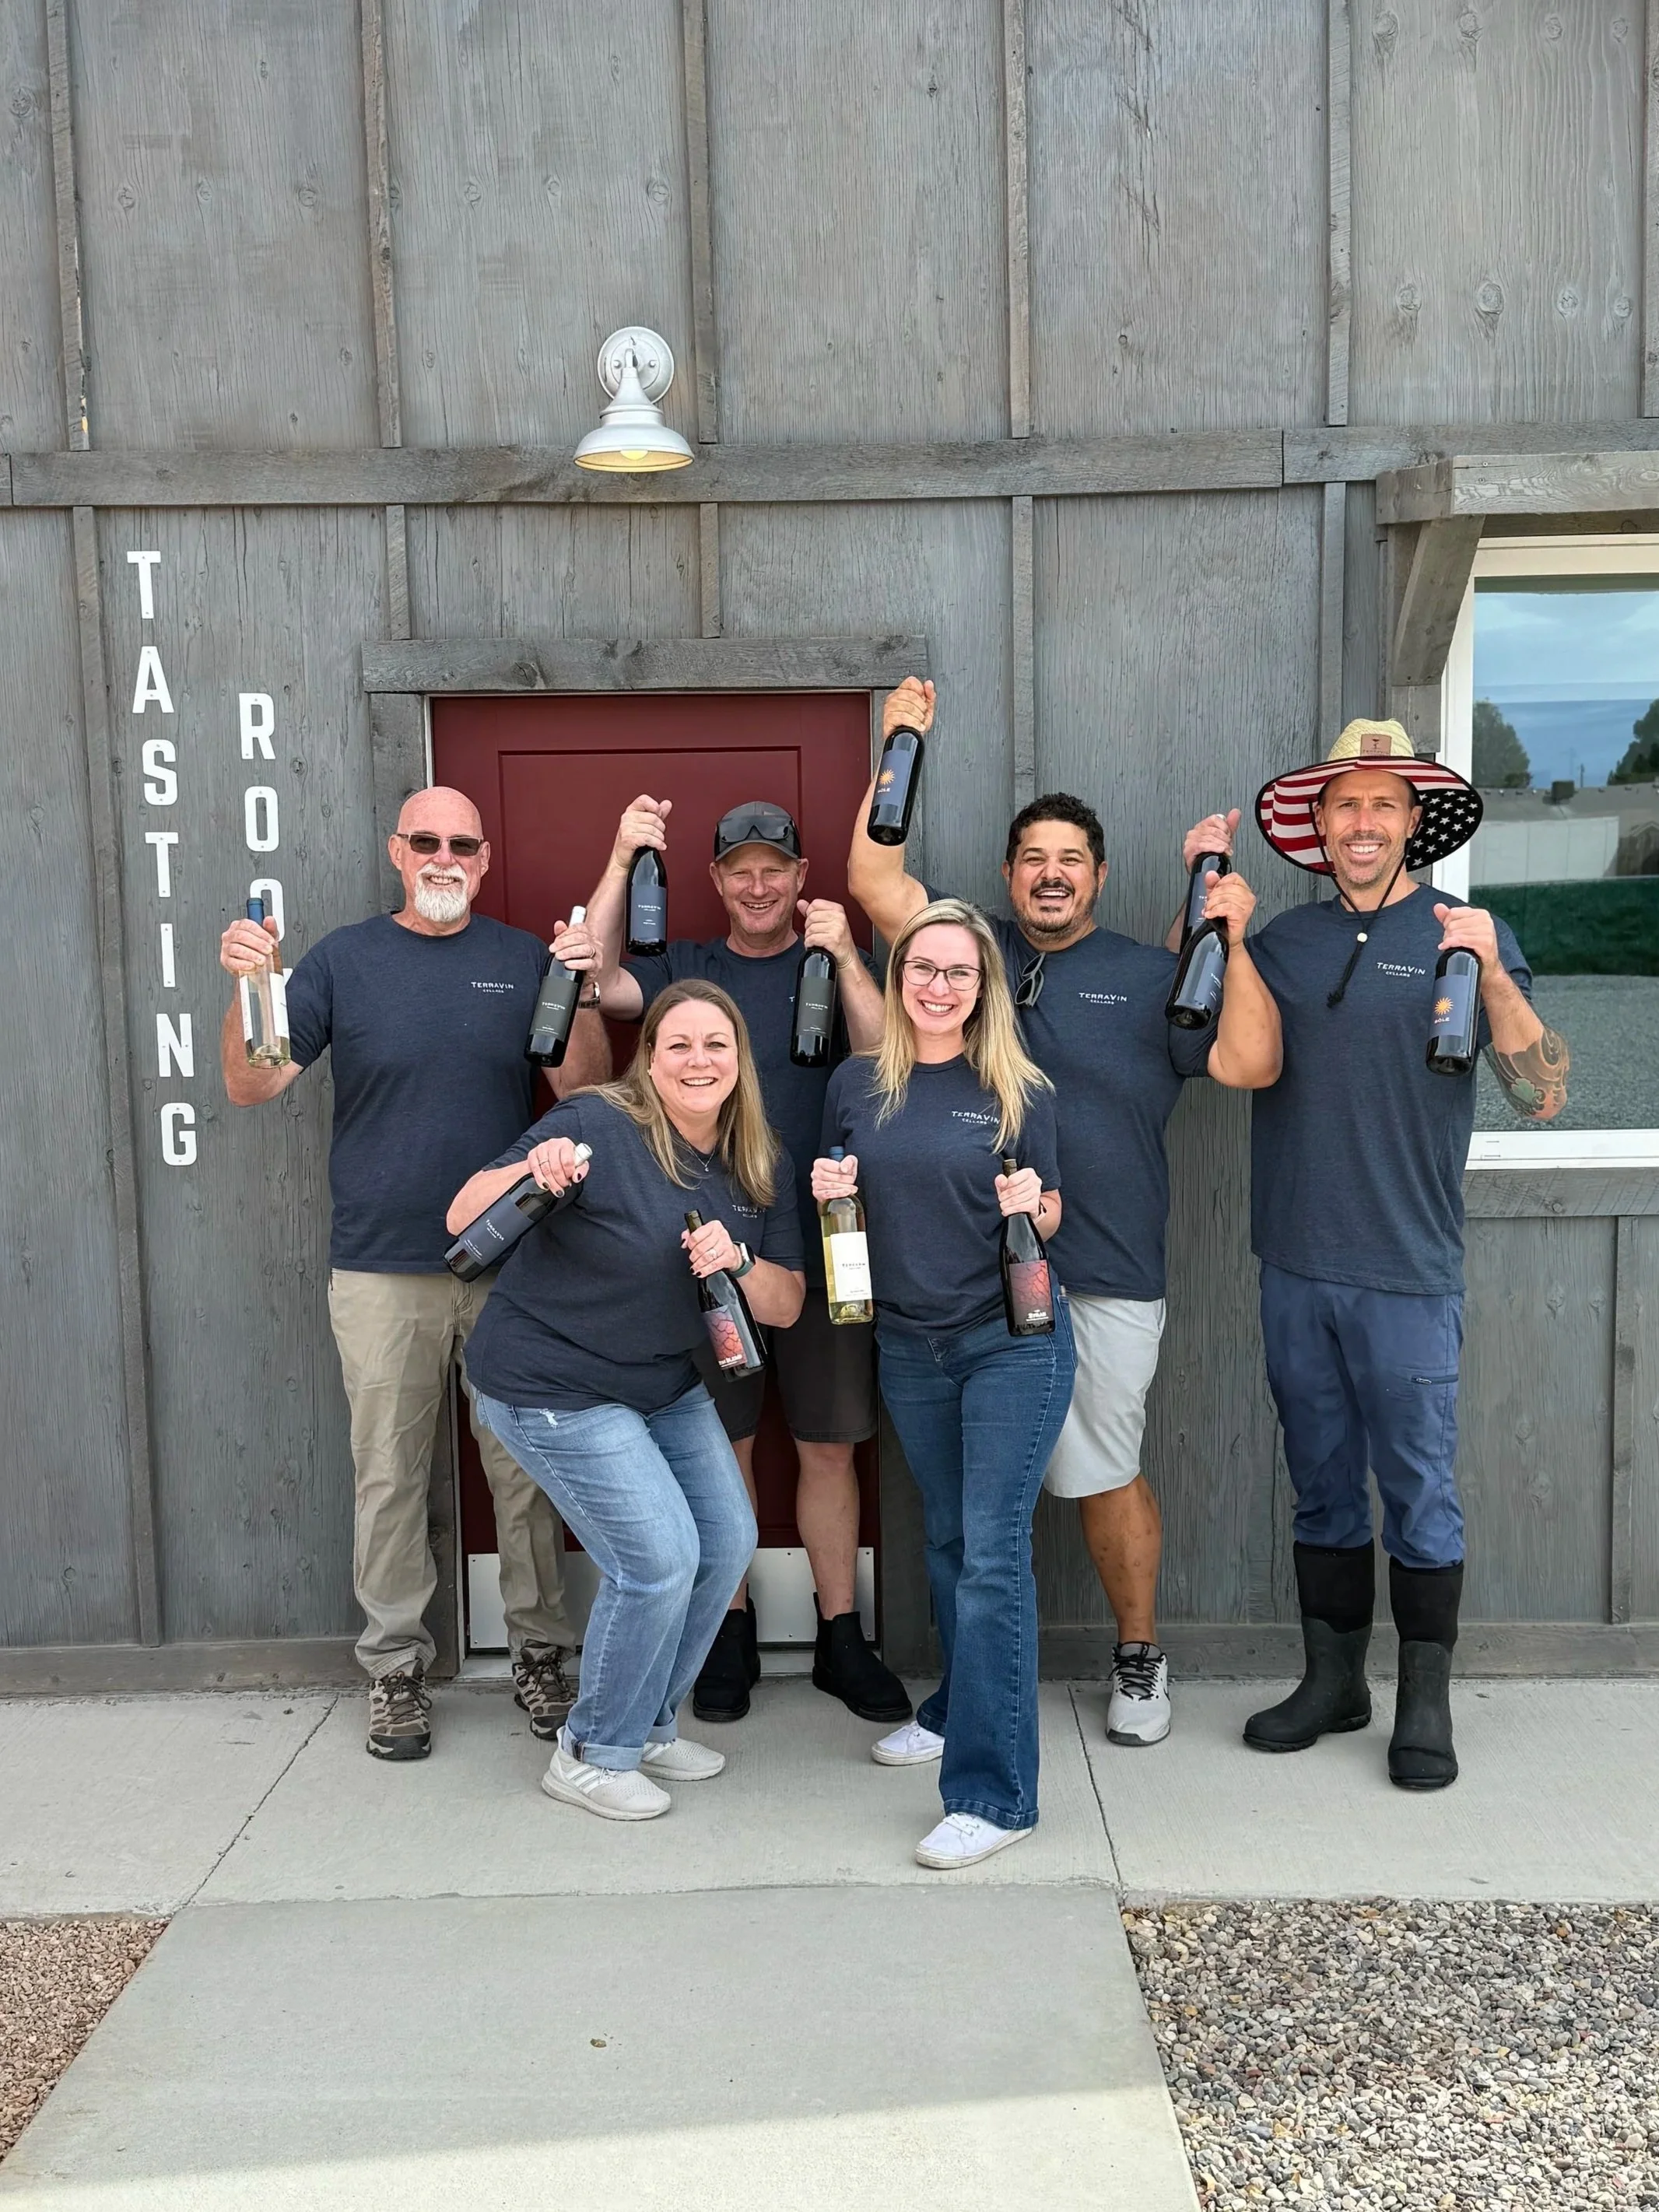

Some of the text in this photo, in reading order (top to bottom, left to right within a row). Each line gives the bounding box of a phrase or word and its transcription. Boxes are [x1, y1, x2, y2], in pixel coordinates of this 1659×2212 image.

[239, 692, 293, 987] ROO
[127, 550, 197, 1166] TASTING
[1377, 962, 1426, 975] TERRAVIN
[470, 981, 514, 990] TERRAVIN
[1079, 992, 1128, 1002] TERRAVIN
[952, 1111, 1001, 1124] TERRAVIN
